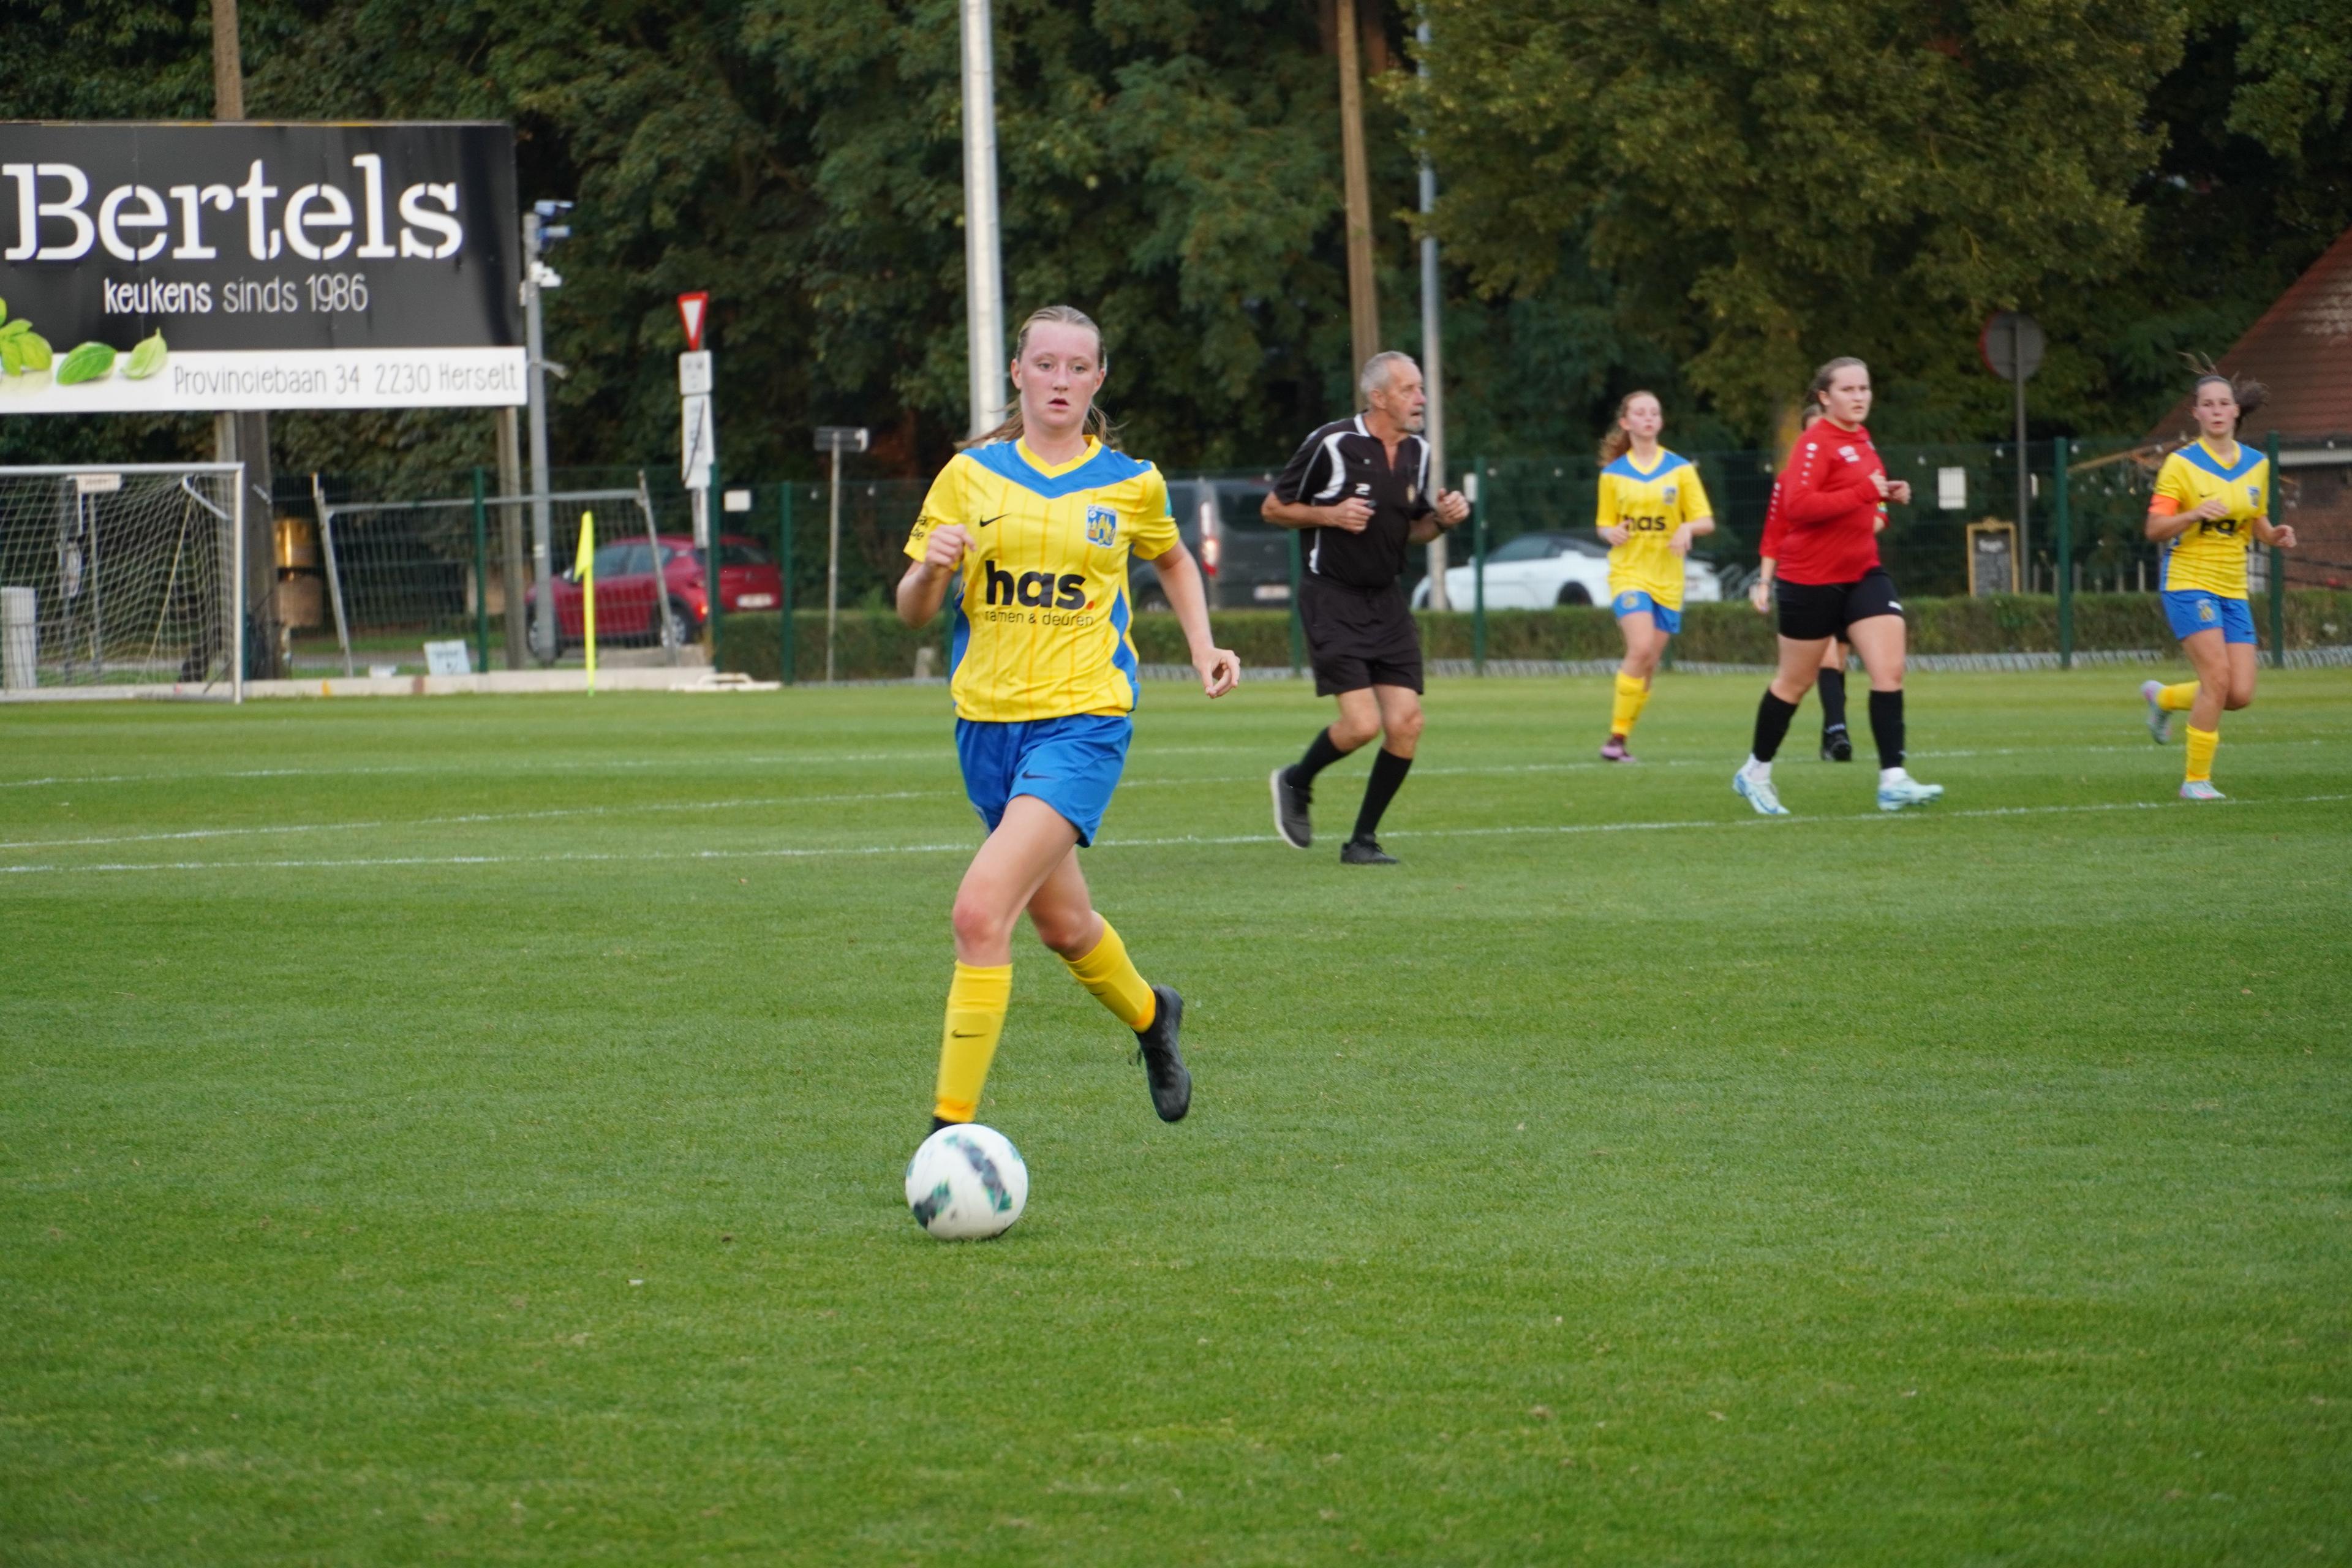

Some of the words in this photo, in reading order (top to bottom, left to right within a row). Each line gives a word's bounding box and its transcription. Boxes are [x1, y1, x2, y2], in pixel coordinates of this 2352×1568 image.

[2, 154, 462, 261] Bertels
[104, 277, 213, 314] keukens
[223, 275, 298, 313] sinds
[306, 273, 368, 313] 1986
[173, 364, 327, 396] Provinciebaan
[335, 363, 360, 395] 34
[375, 363, 431, 394] 2230
[439, 361, 518, 391] Herselt
[985, 610, 1024, 623] ramen
[1028, 613, 1036, 624] &
[1042, 612, 1095, 627] deuren
